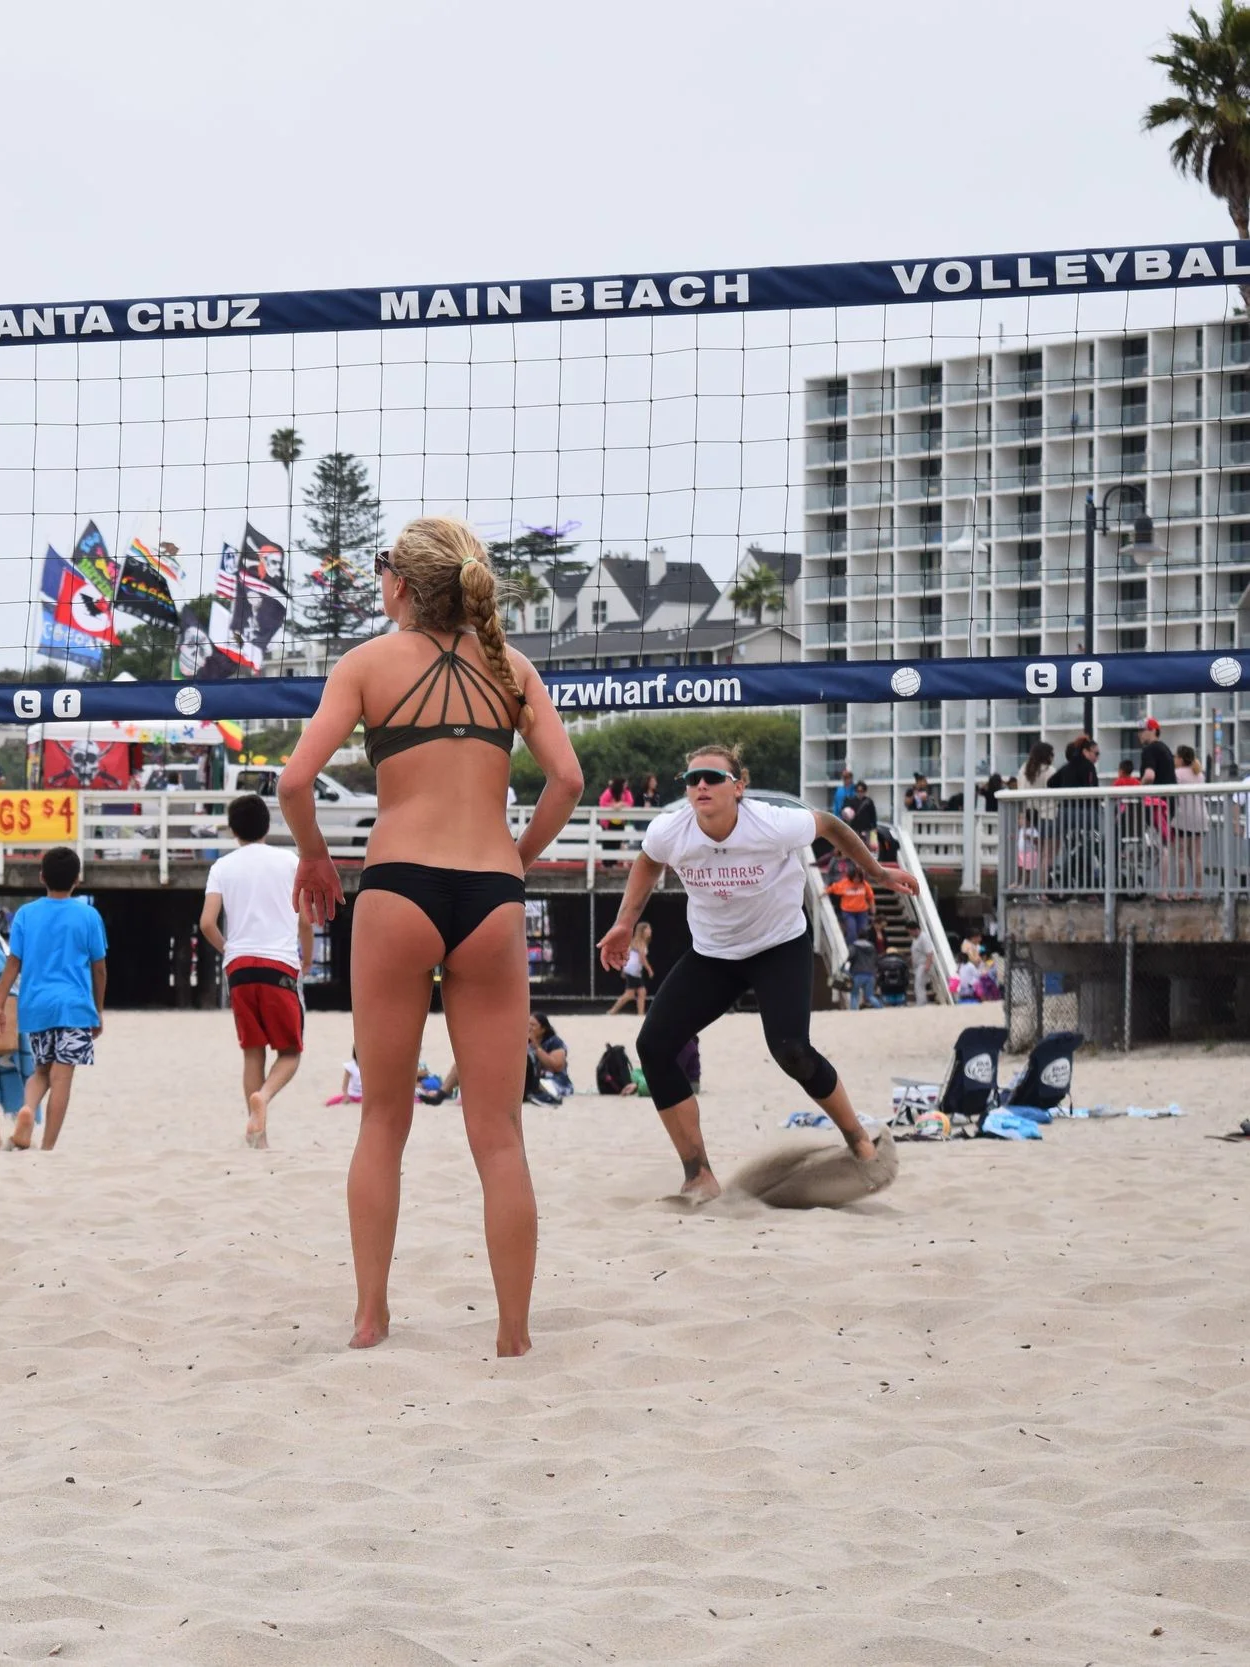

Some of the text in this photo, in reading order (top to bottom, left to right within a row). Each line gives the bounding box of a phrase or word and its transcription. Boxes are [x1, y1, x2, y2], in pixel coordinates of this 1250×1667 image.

[891, 245, 1250, 295] VOLLEYBAL
[379, 273, 750, 321] MAIN BEACH
[127, 298, 261, 333] CRUZ
[42, 796, 75, 834] $4
[679, 866, 712, 880] SAINT
[710, 879, 760, 887] VOLLEYBALL
